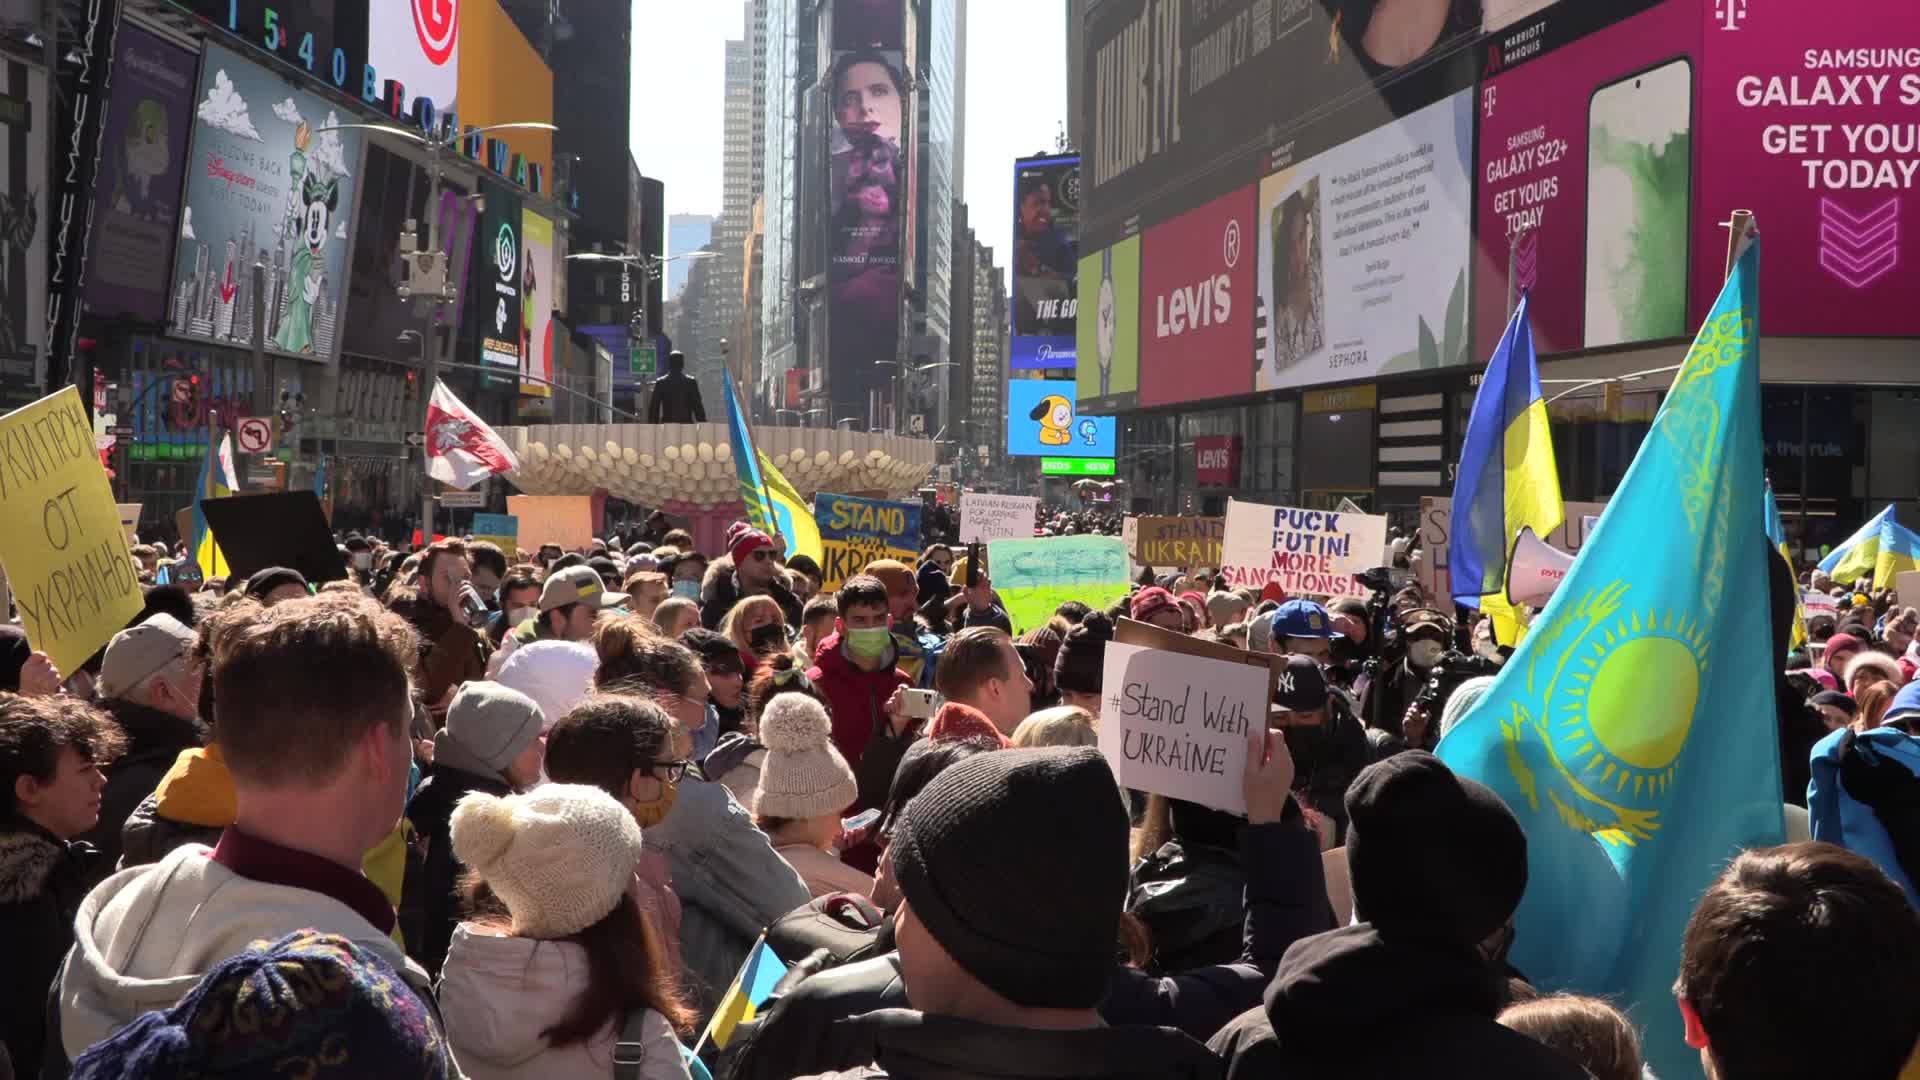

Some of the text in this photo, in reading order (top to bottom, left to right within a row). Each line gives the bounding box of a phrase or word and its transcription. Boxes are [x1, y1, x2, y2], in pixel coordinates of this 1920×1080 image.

[1504, 21, 1547, 49] MARRIOTT
[1504, 39, 1541, 65] MARQUIS
[1804, 48, 1920, 69] SAMSUNG
[1736, 74, 1890, 107] GALAXY
[1507, 125, 1546, 151] SAMSUNG
[1762, 123, 1920, 154] GET YOU
[1486, 138, 1568, 183] GALAXY S22+
[1802, 159, 1919, 189] TODAY
[1494, 175, 1559, 214] GET YOURS
[1506, 204, 1545, 235] TODAY
[1036, 299, 1058, 320] THE
[1328, 350, 1368, 369] SEPHORA
[43, 486, 84, 551] ОТ
[830, 499, 905, 536] STAND
[1273, 508, 1340, 533] PUCK
[1271, 531, 1350, 557] FUTIN!
[1272, 551, 1331, 575] MORE
[18, 530, 137, 651] УКРАИНЫ
[1109, 683, 1249, 738] #Stand With
[1122, 729, 1227, 777] UKRAINE
